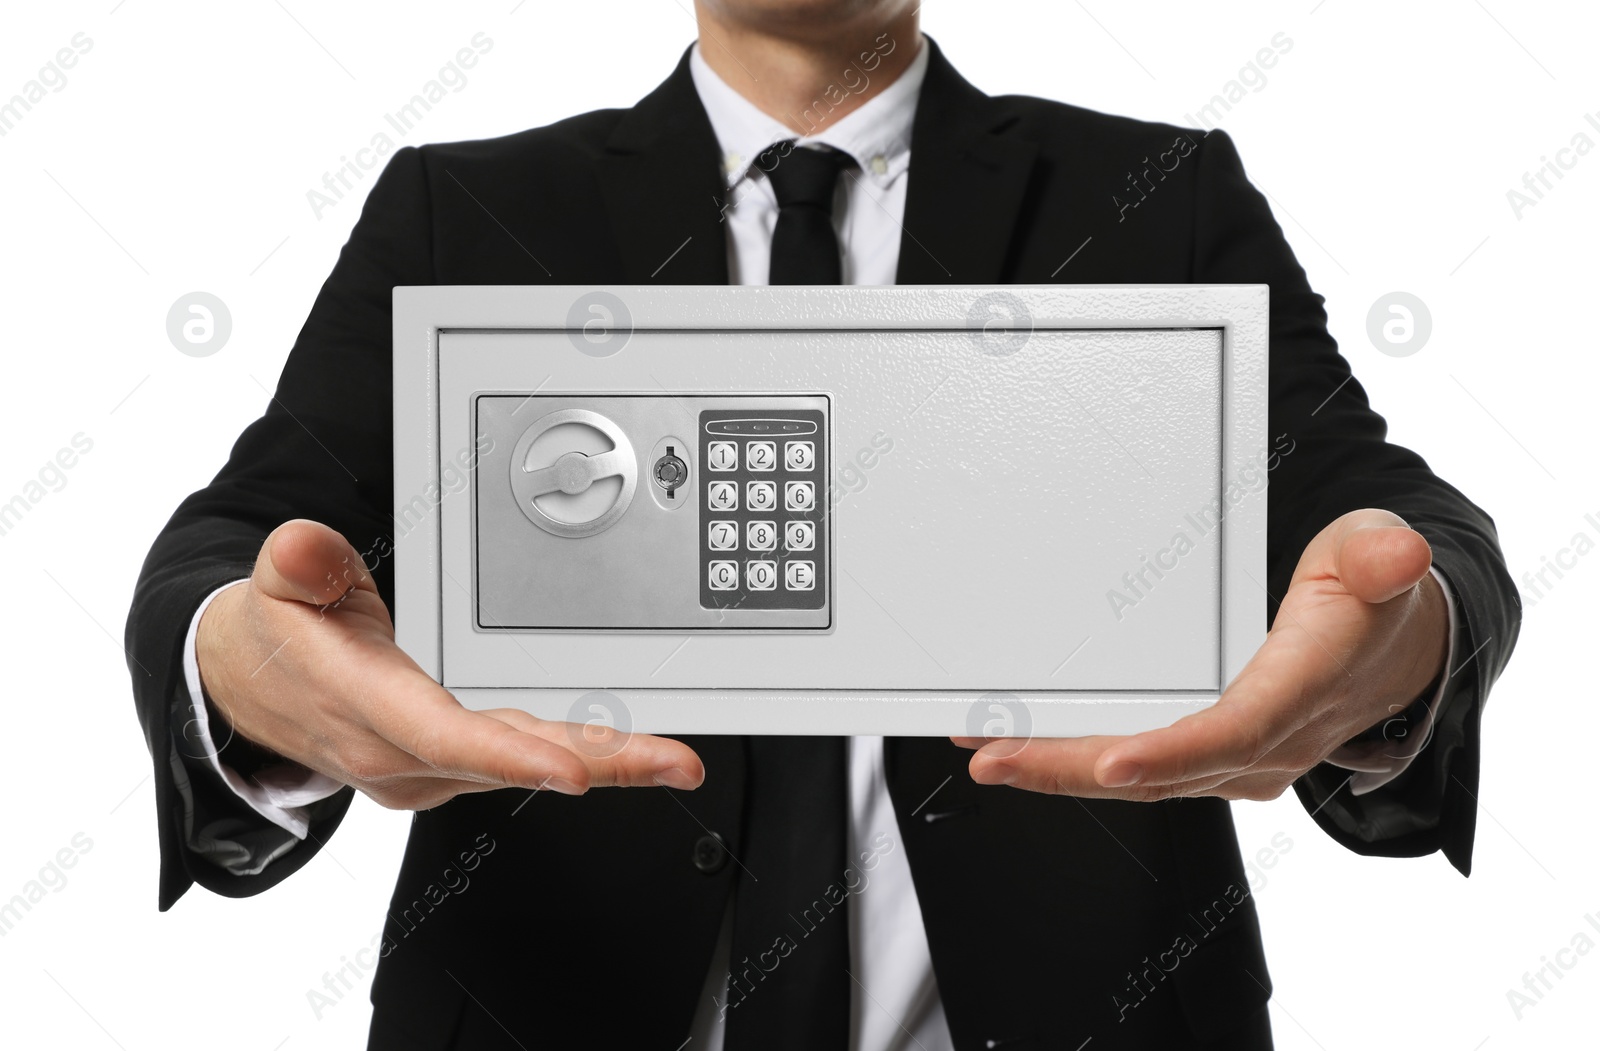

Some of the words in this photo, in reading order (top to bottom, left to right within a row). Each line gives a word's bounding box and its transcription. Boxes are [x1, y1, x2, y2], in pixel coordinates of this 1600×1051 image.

[719, 449, 726, 464] 1
[756, 449, 766, 464] 2
[795, 449, 804, 464] 3
[718, 488, 728, 504] 4
[756, 488, 766, 504] 5
[795, 488, 805, 504] 6
[719, 528, 728, 543] 7
[757, 528, 766, 543] 8
[795, 528, 805, 543] 9
[718, 568, 729, 583] C
[757, 568, 767, 583] 0
[795, 568, 805, 583] E
